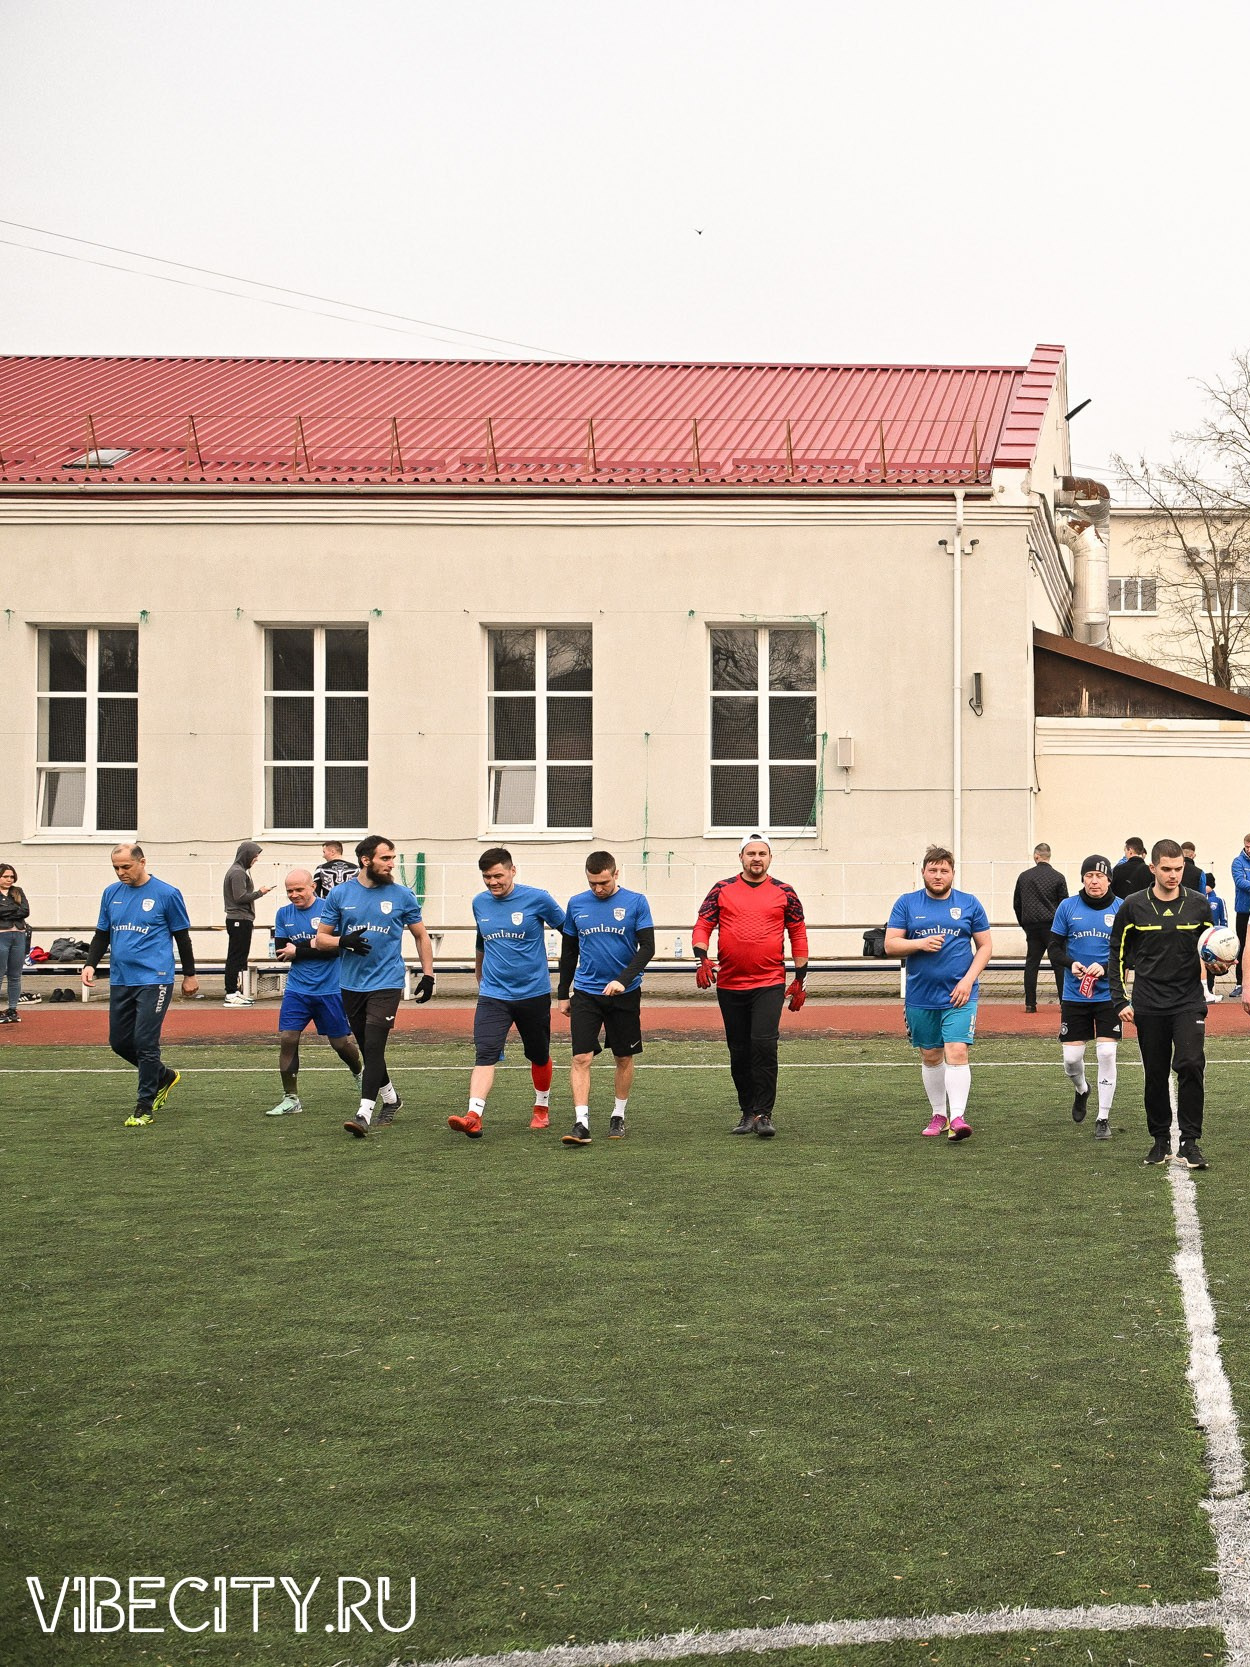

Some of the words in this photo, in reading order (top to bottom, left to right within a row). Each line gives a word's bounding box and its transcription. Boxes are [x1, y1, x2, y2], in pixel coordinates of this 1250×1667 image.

[347, 922, 391, 935] Samland
[580, 923, 625, 936] Samland
[914, 925, 961, 937] Samland
[288, 931, 317, 942] Samlan
[483, 929, 526, 942] Samland
